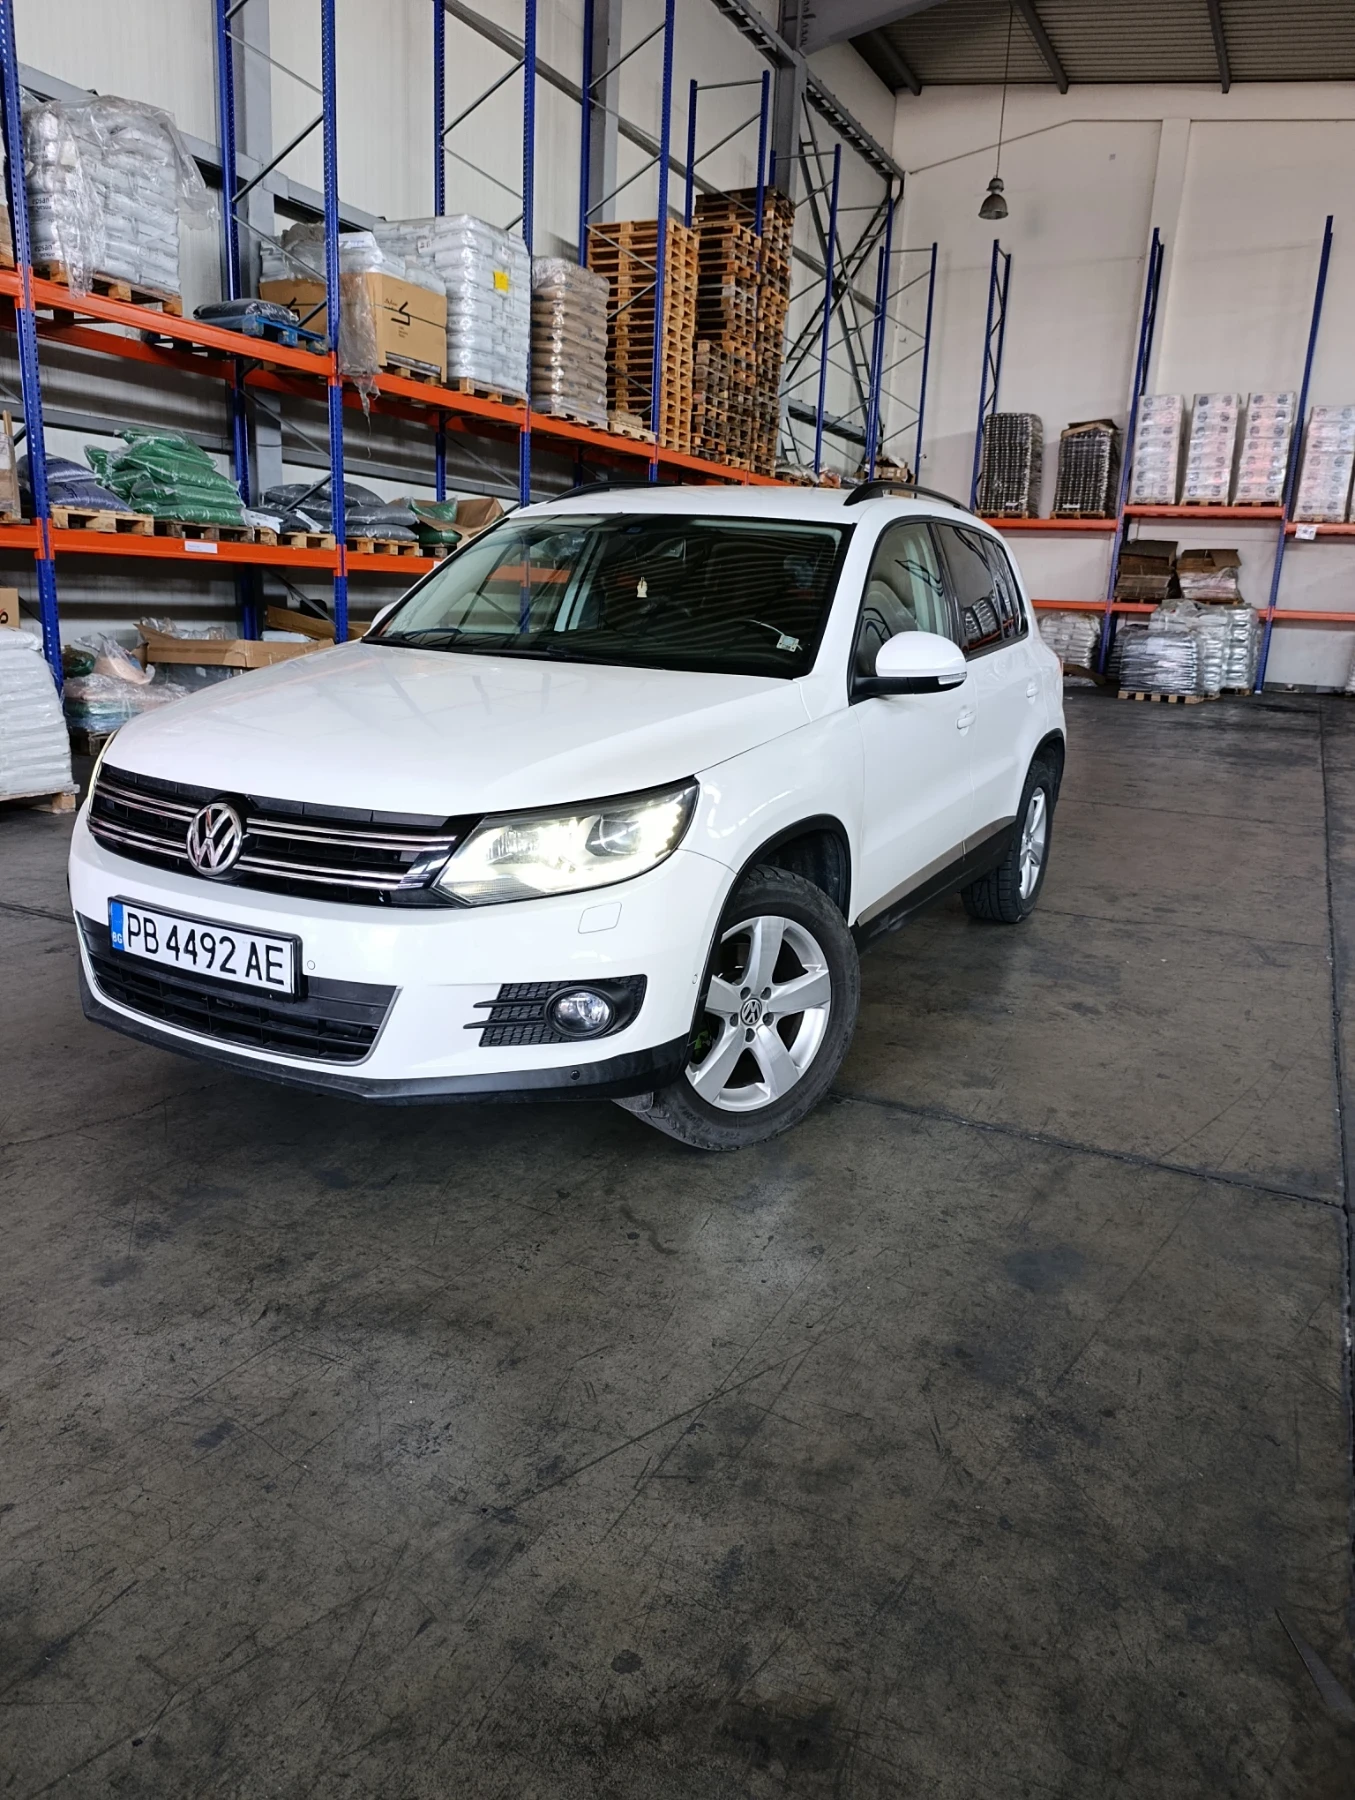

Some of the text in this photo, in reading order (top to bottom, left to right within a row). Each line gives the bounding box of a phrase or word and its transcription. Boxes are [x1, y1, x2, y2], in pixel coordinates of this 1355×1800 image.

[112, 931, 123, 945] BG
[127, 912, 285, 985] PB 4492 AE
